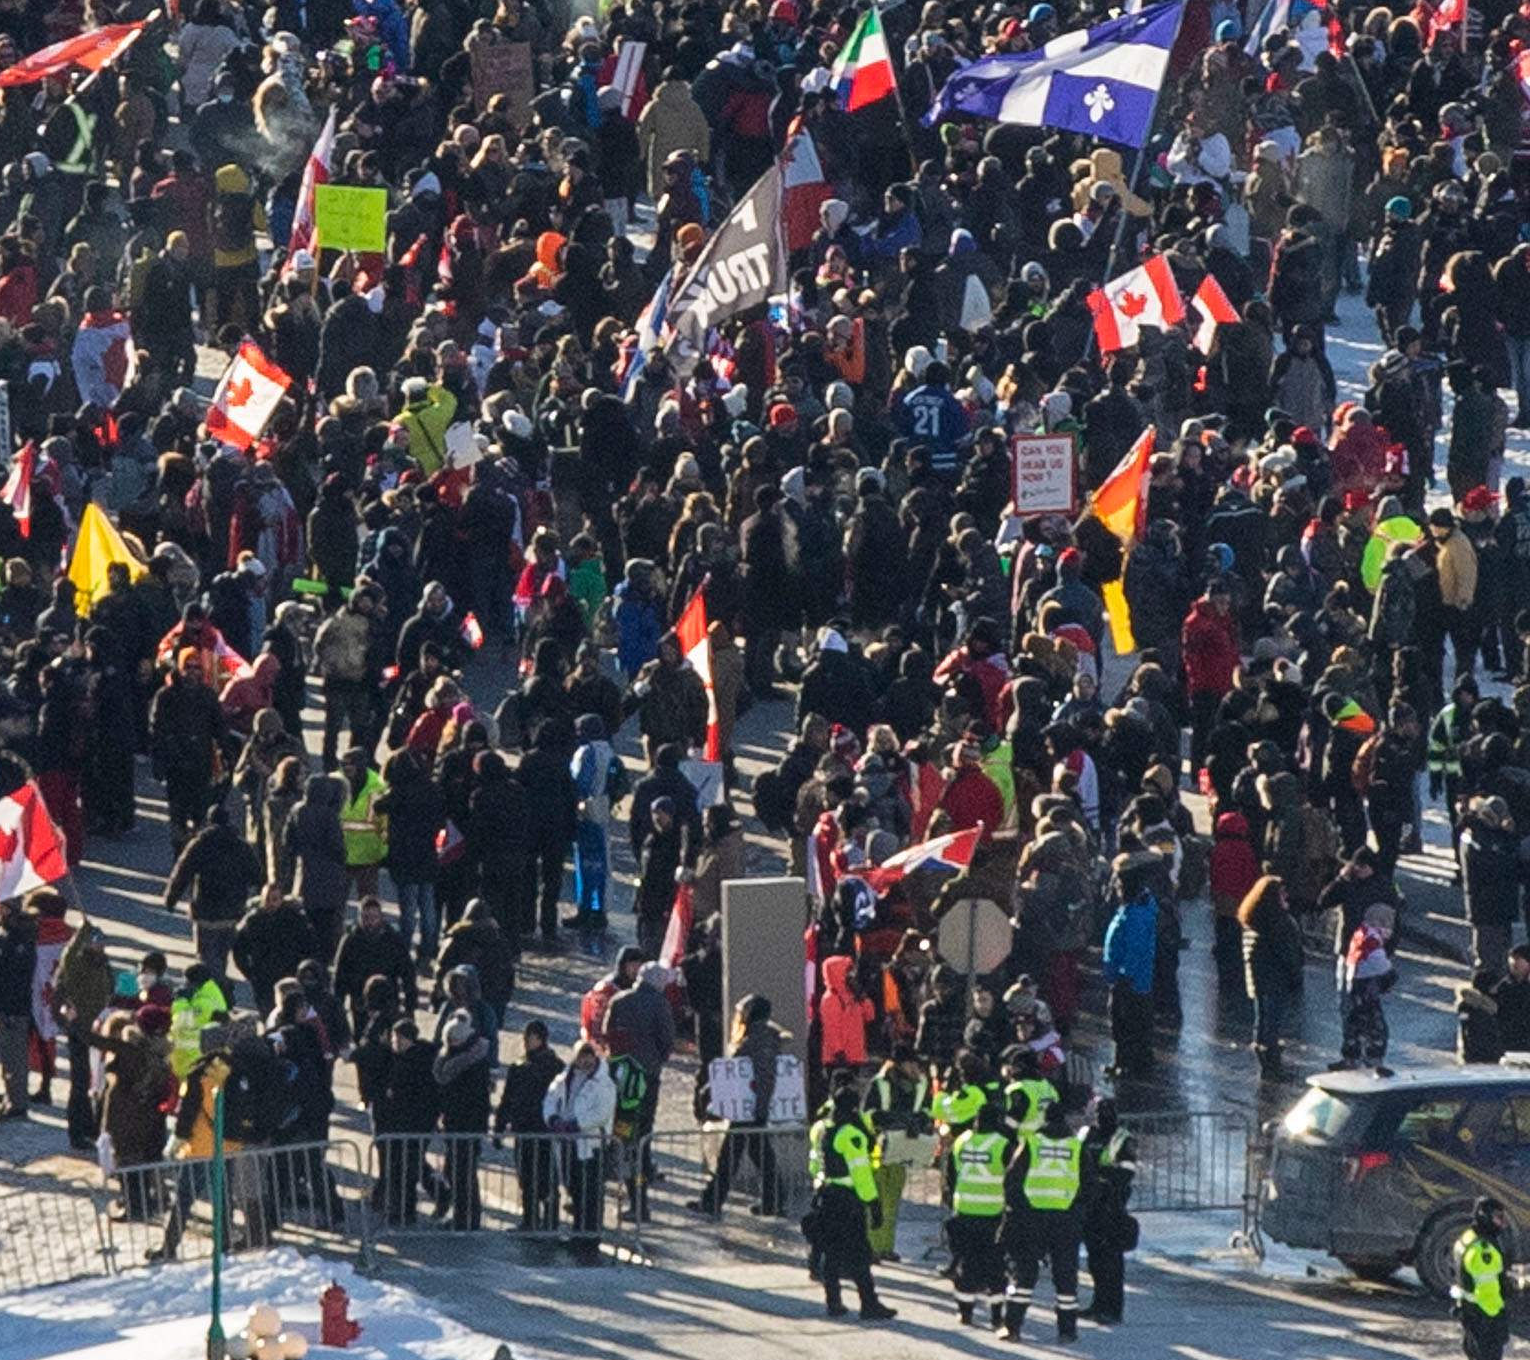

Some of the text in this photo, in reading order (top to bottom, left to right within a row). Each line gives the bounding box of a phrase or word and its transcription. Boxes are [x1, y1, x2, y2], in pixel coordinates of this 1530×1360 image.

[914, 405, 940, 437] 21
[1020, 445, 1066, 456] CAN YOU
